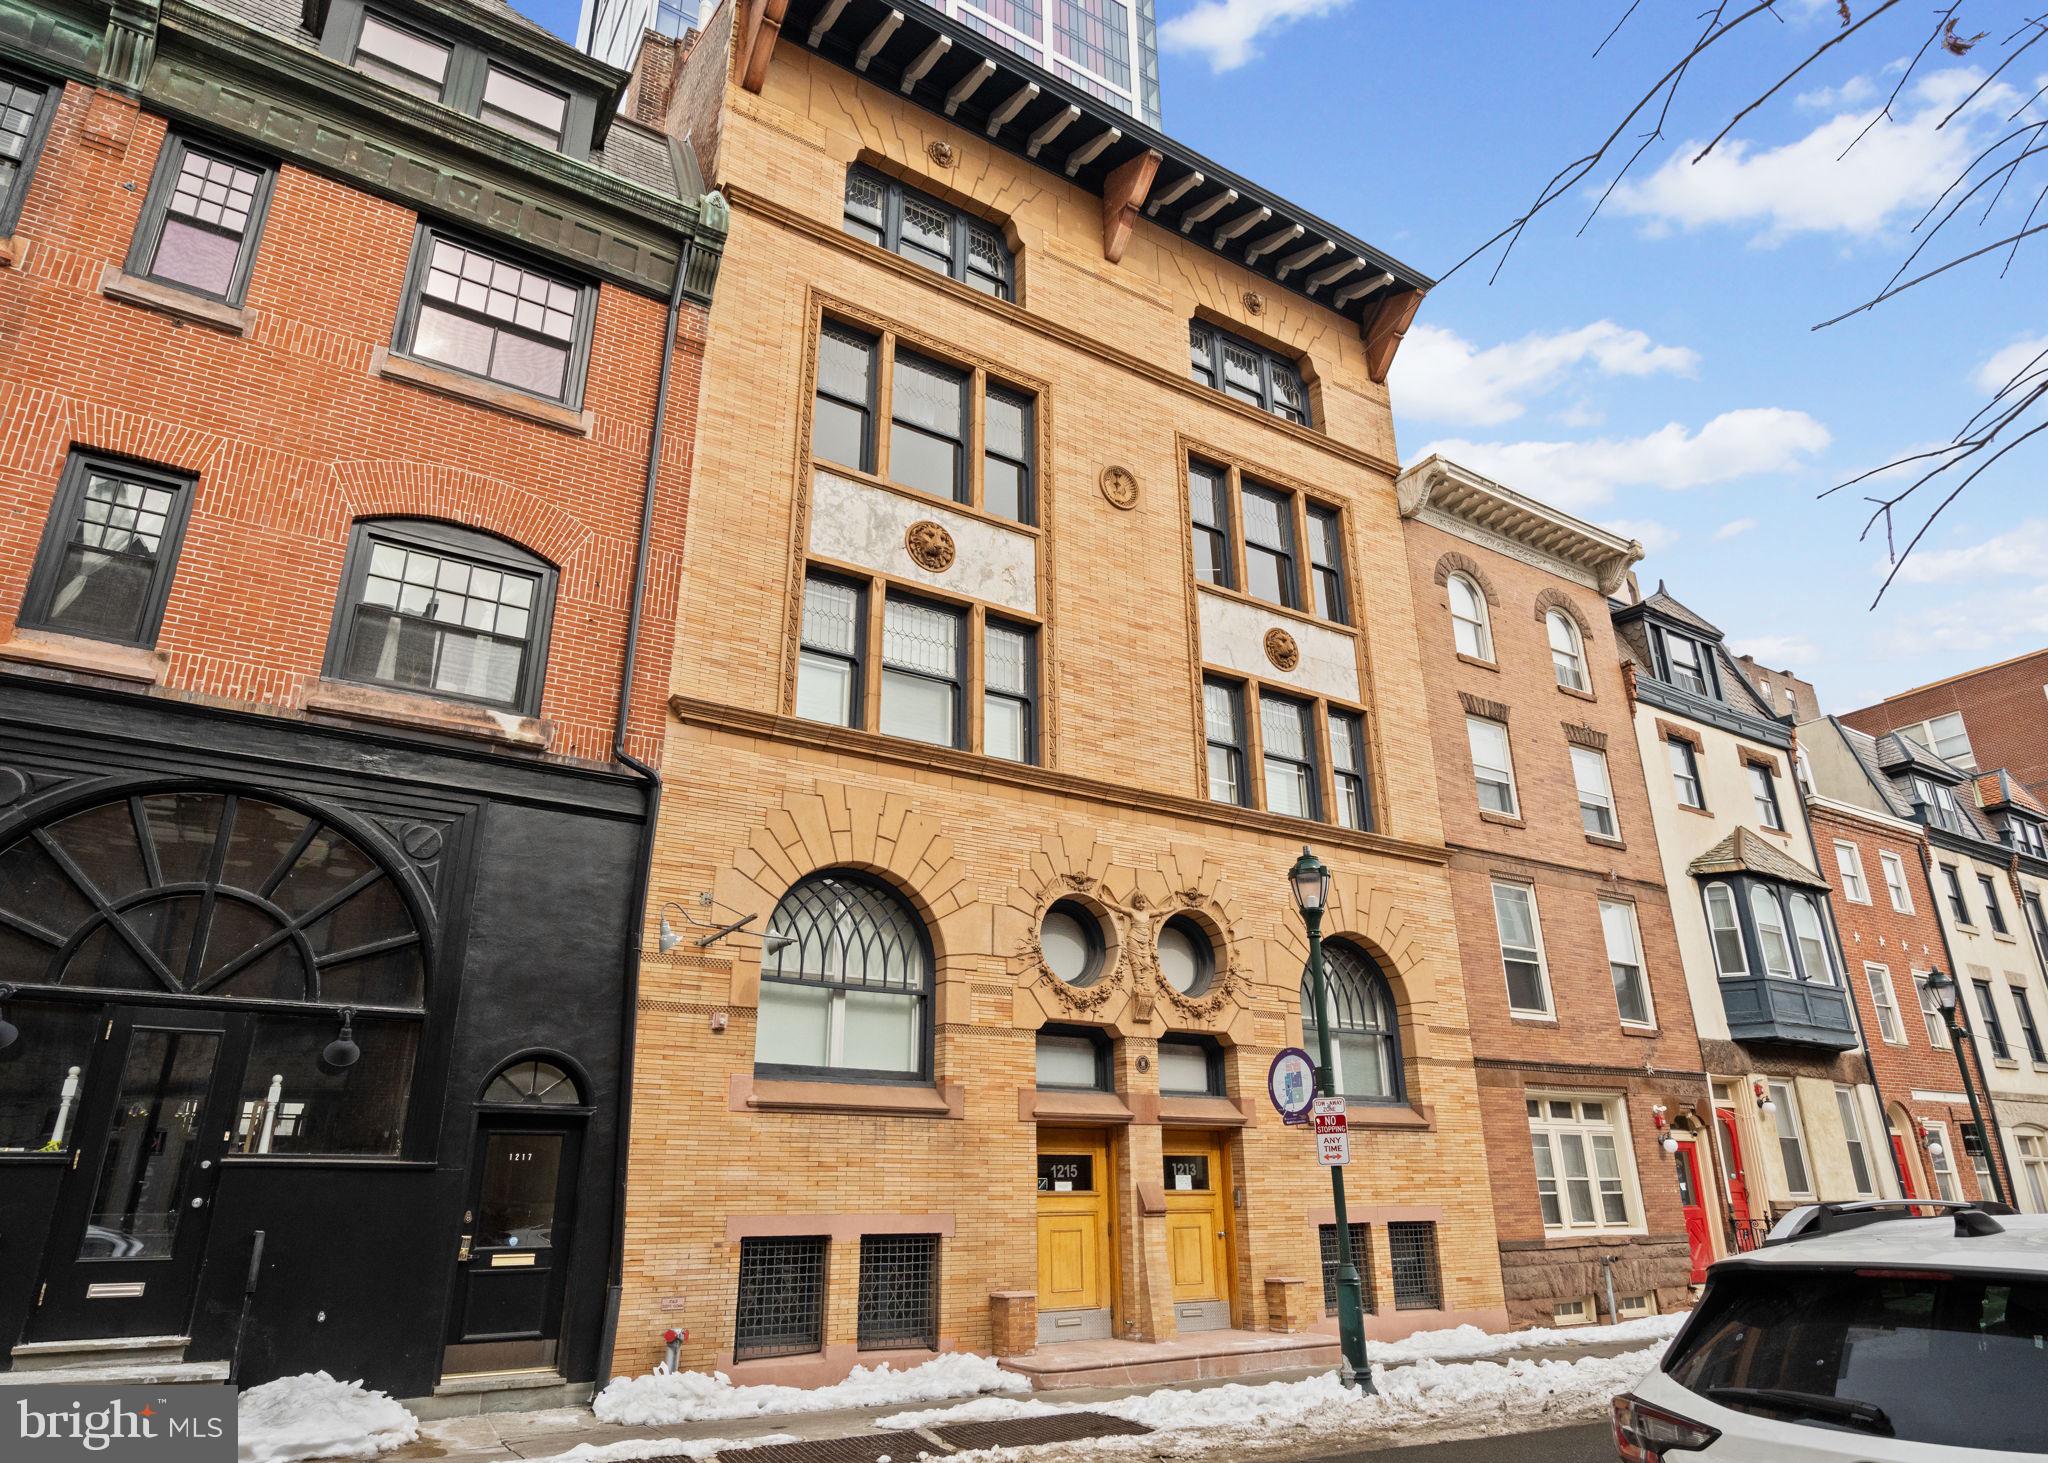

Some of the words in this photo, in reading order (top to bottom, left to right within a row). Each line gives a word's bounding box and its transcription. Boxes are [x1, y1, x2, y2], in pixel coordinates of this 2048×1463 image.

[1324, 1115, 1336, 1126] NO
[1316, 1126, 1346, 1134] STOPPING
[509, 1153, 532, 1161] 1217
[1050, 1164, 1078, 1178] 1215
[1171, 1163, 1197, 1176] 1213
